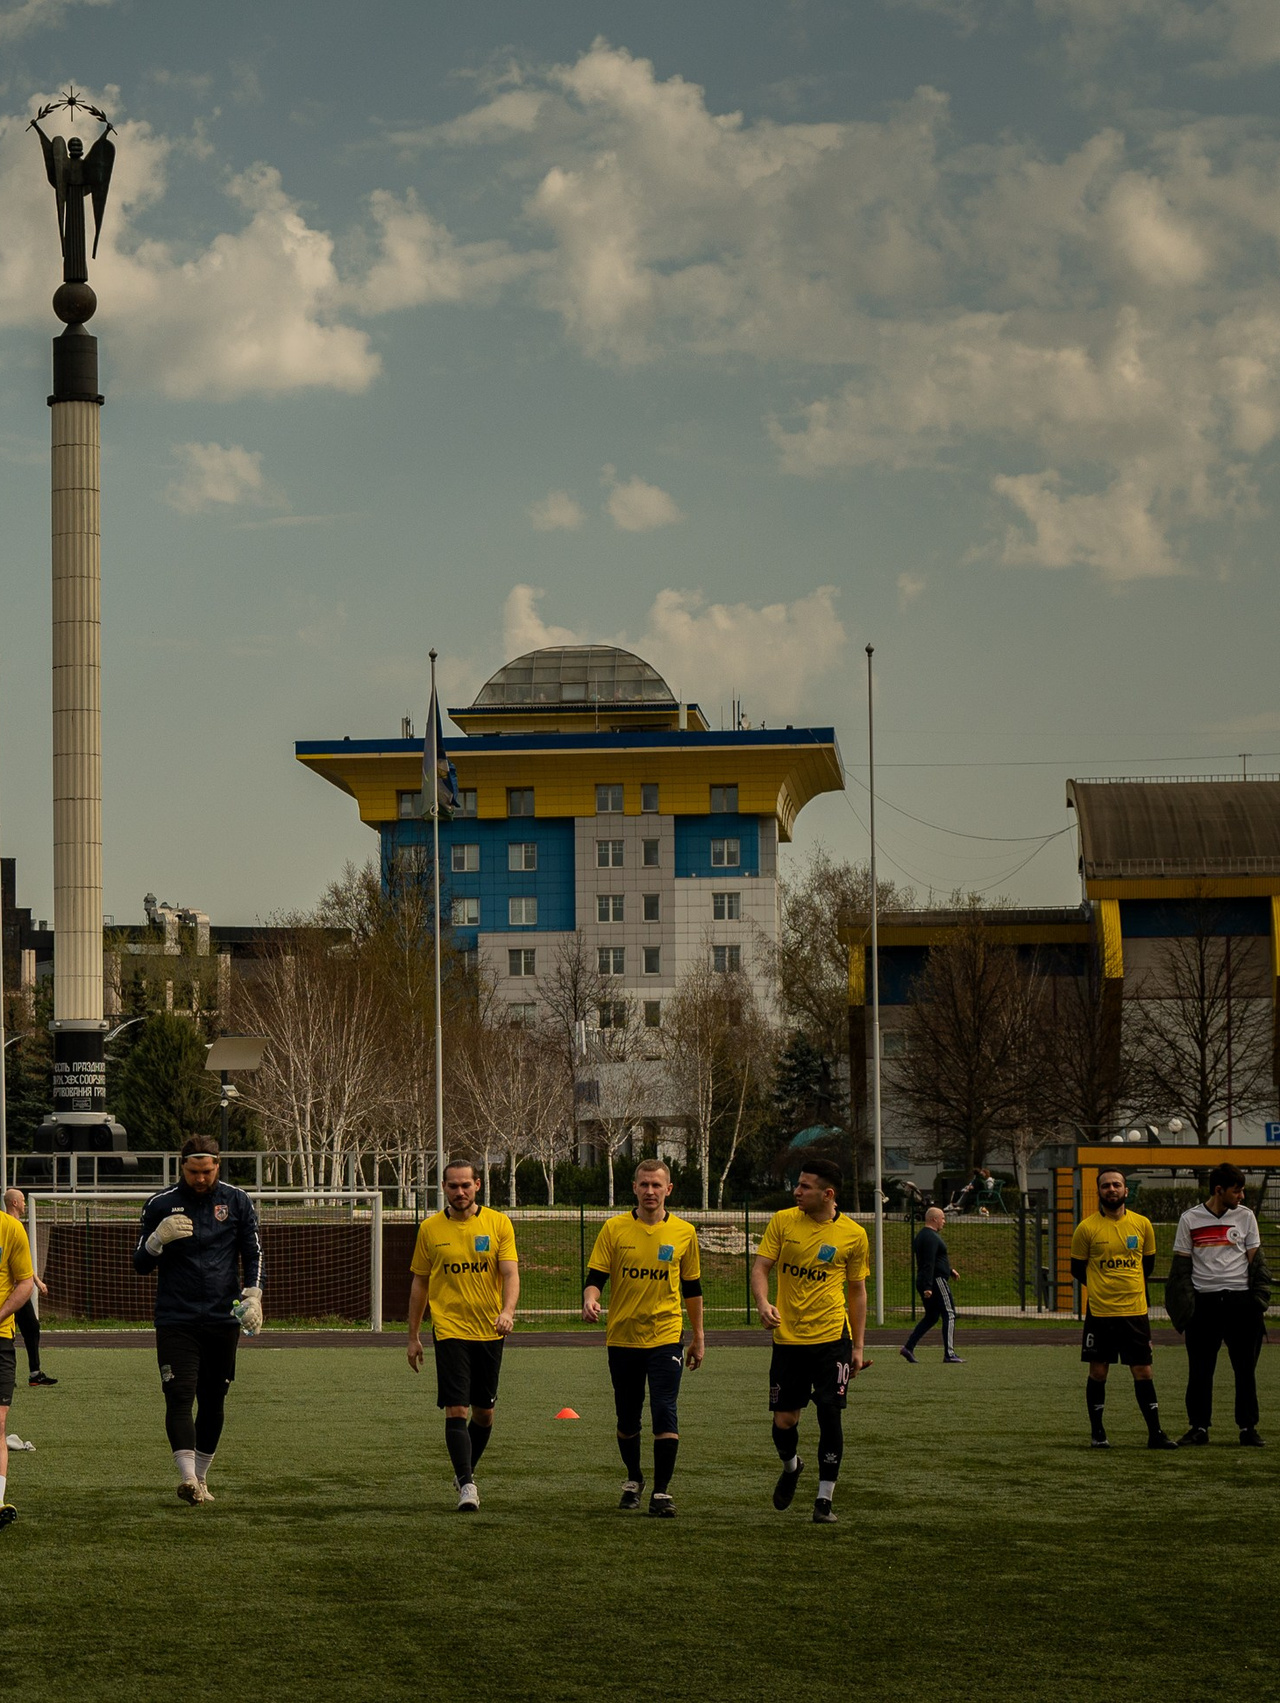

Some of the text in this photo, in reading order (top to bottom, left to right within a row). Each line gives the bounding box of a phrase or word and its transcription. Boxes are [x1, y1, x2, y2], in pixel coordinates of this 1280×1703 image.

[1271, 1124, 1280, 1140] P
[444, 1262, 488, 1275] ГОРКИ
[782, 1262, 827, 1282] ГОРКИ
[1100, 1259, 1136, 1269] ГОРКИ
[622, 1267, 669, 1281] ГОРКИ
[1085, 1332, 1095, 1348] 6
[836, 1361, 850, 1385] 10
